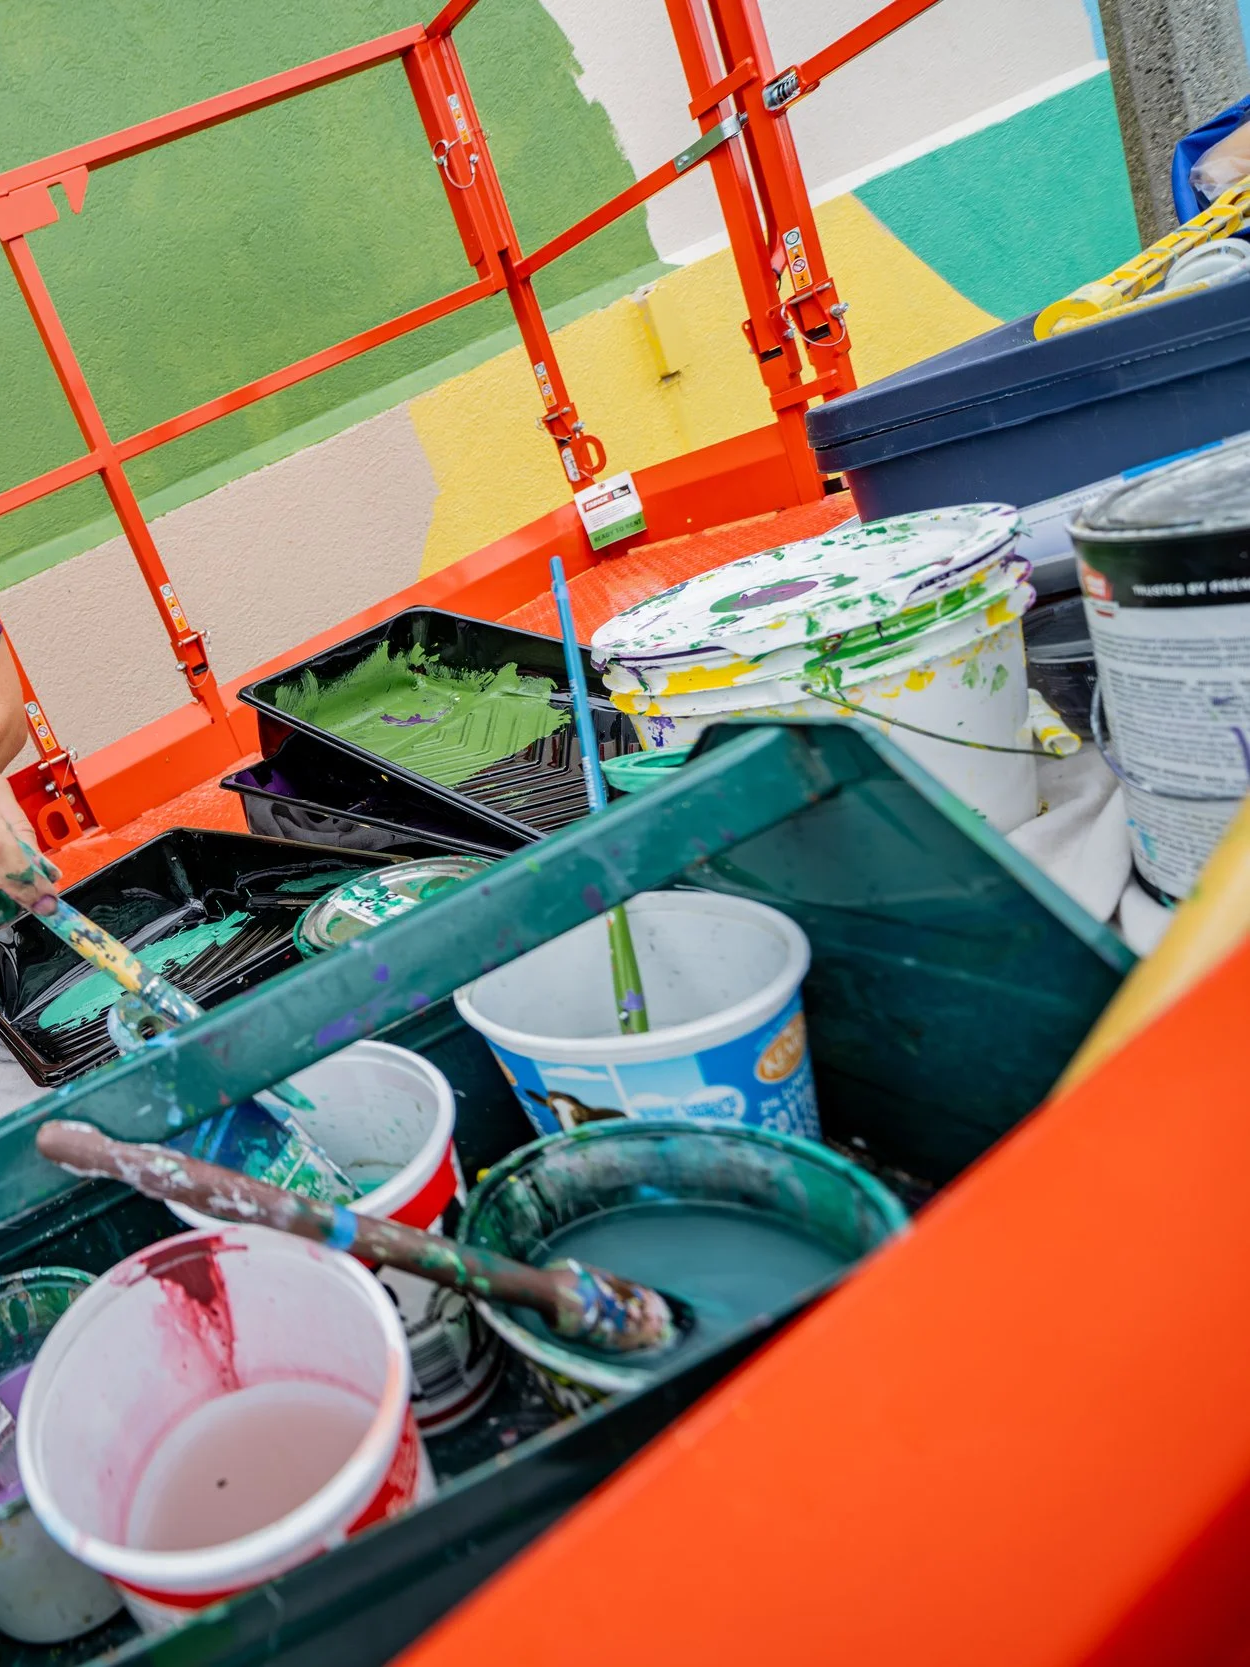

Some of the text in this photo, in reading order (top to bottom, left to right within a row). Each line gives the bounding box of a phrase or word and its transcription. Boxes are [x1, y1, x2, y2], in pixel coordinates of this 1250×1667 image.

[594, 518, 642, 542] READY TO RENT
